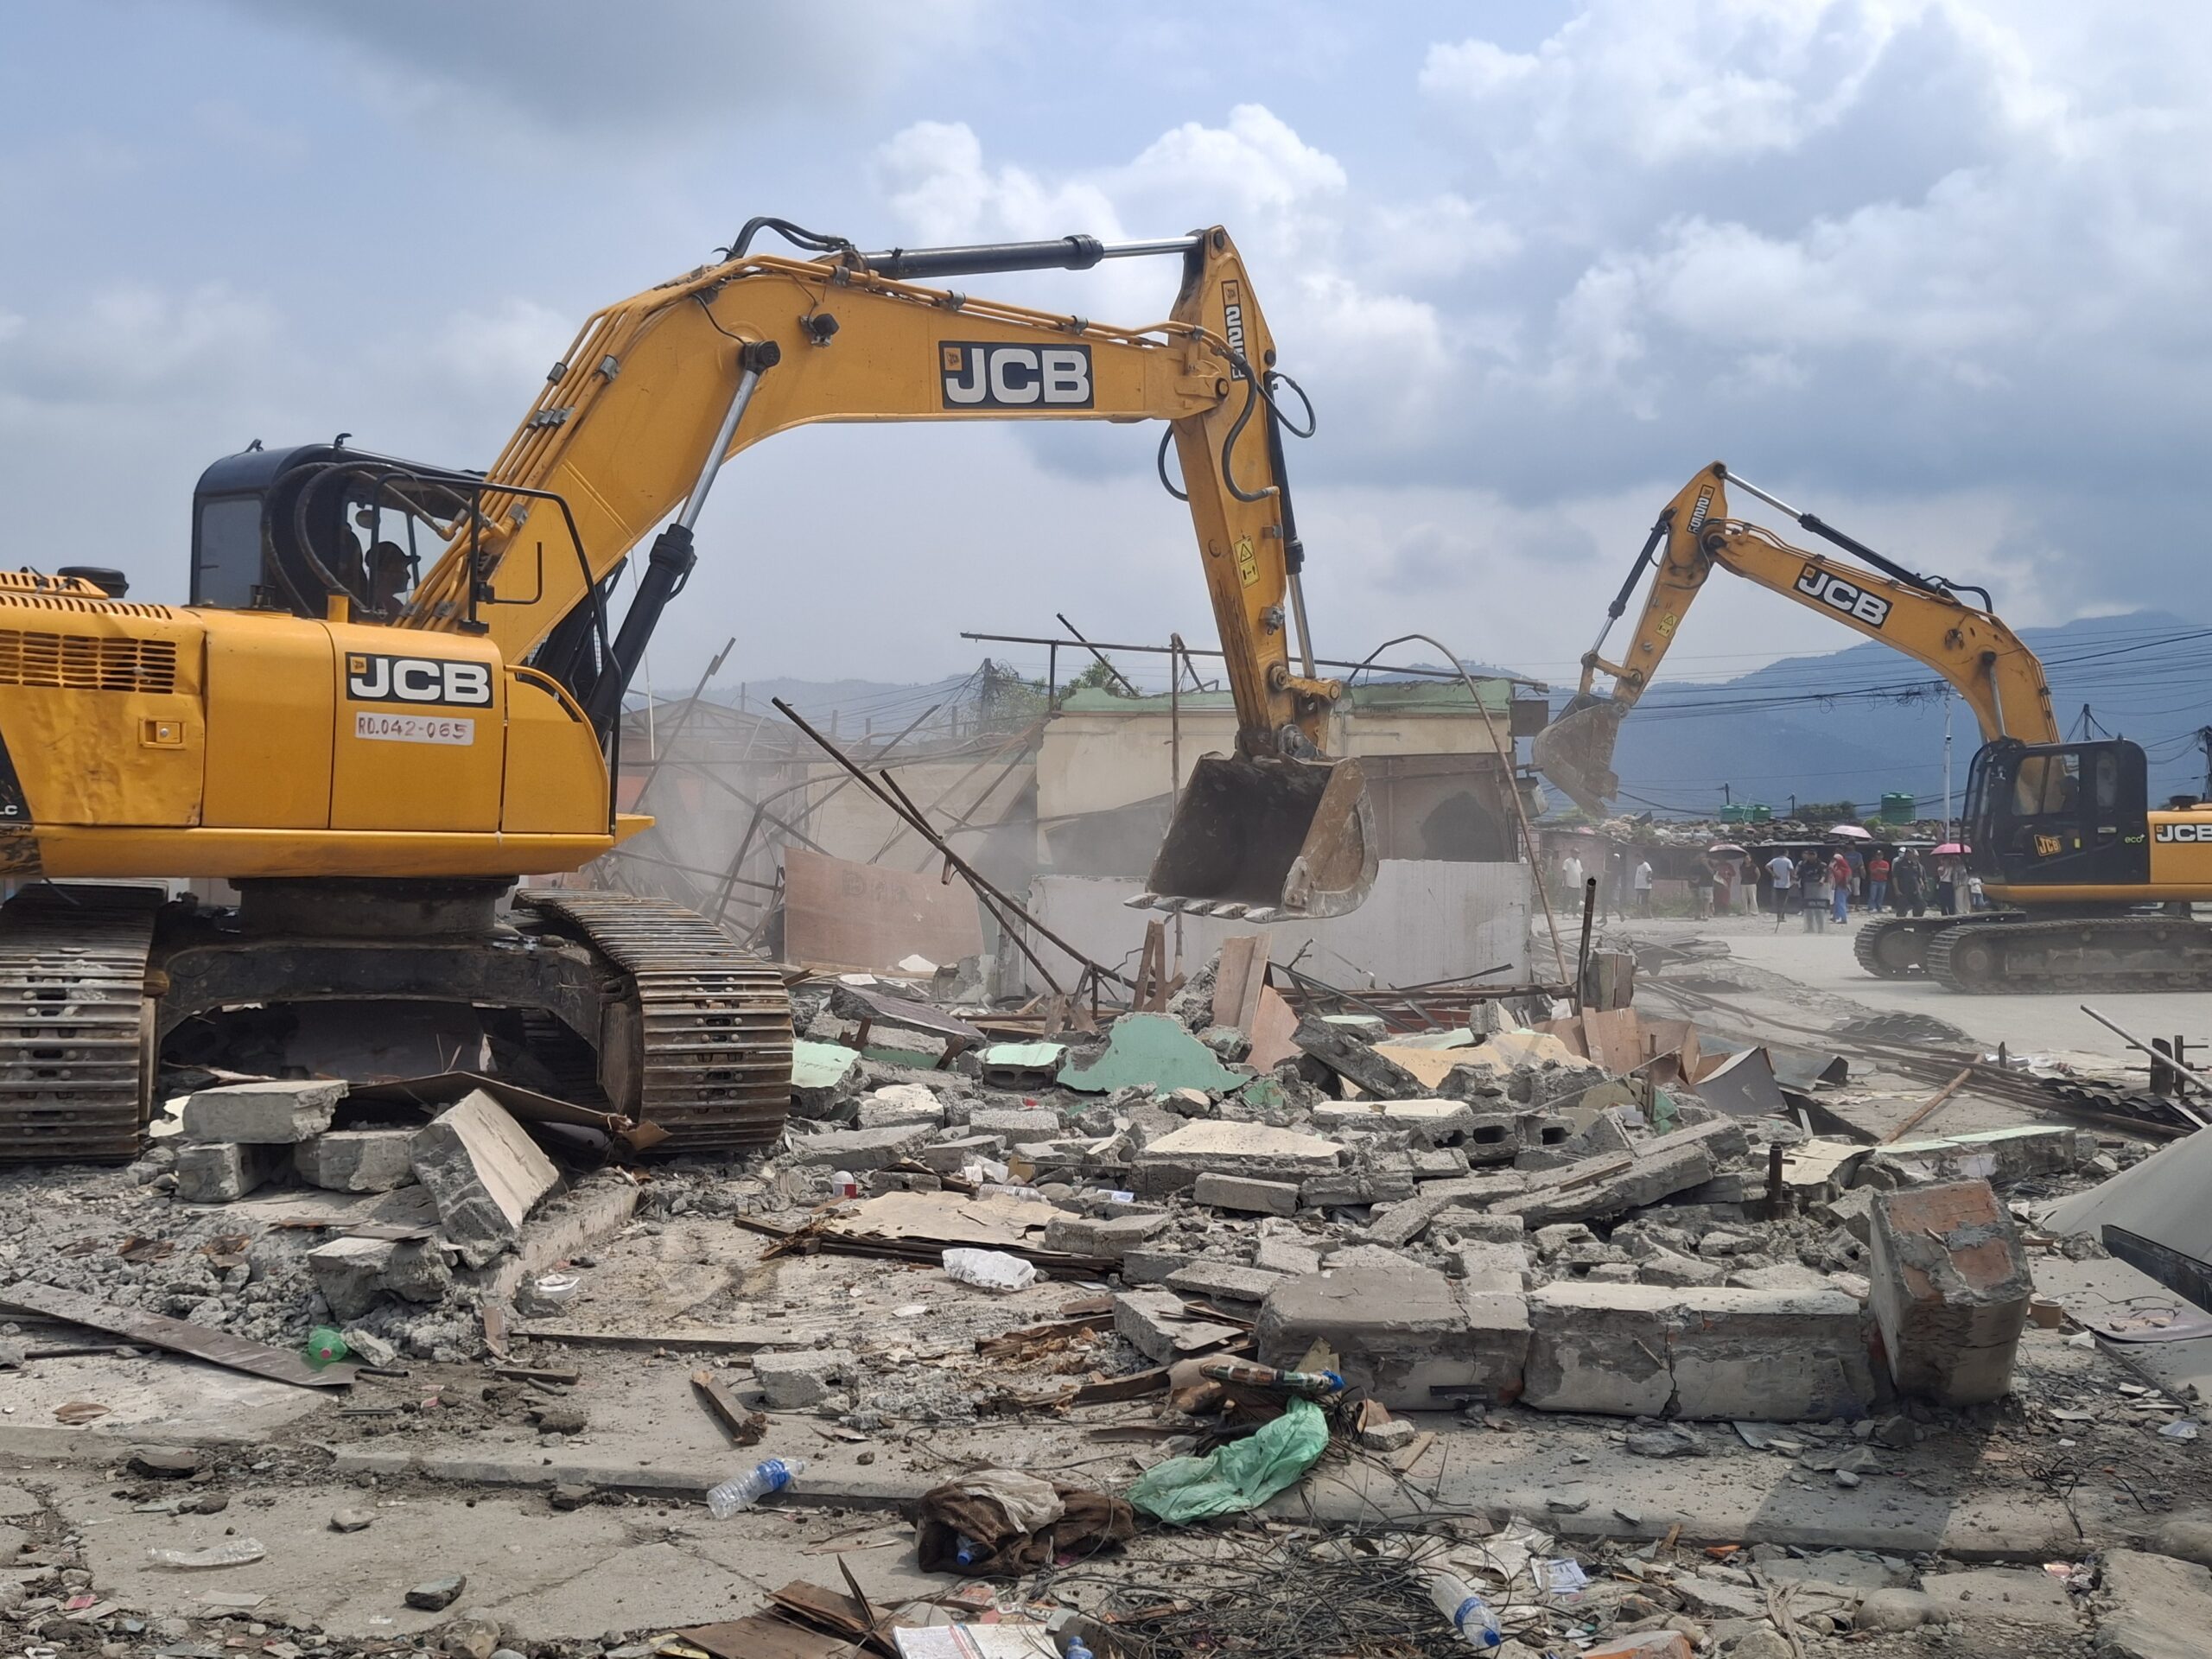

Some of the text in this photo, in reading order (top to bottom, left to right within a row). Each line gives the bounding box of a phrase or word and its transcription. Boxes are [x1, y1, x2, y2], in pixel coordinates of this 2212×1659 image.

[946, 347, 1090, 403] JCB
[1798, 573, 1887, 625] JCB
[351, 658, 490, 703] JCB
[2039, 837, 2058, 854] JCB
[2157, 825, 2212, 842] JCB
